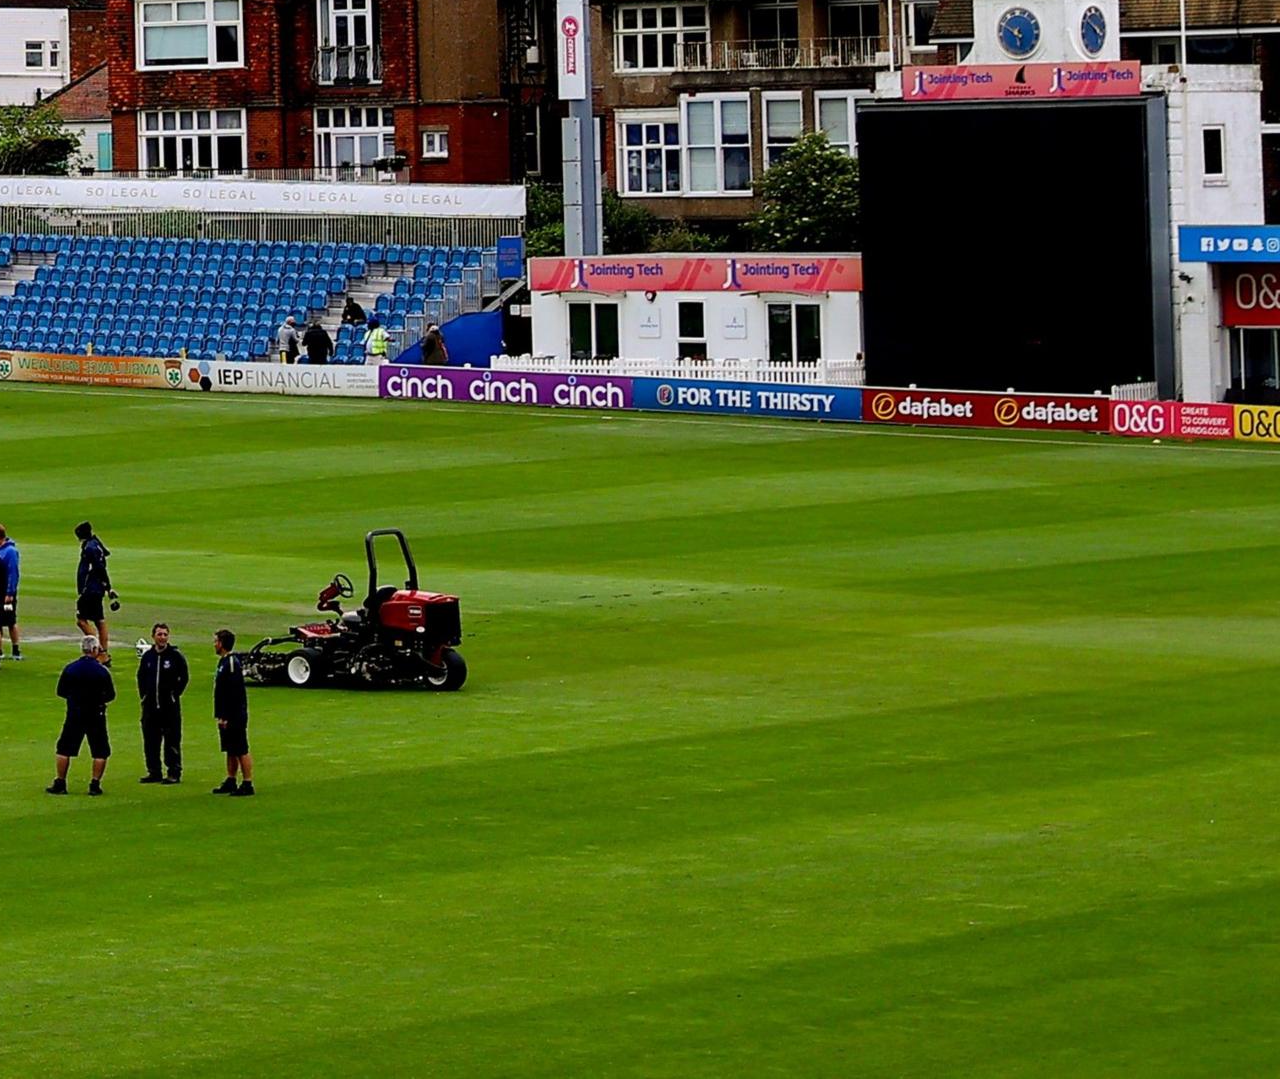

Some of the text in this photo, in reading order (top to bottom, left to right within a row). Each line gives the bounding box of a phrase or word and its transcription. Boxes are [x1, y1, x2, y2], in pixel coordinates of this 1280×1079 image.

[928, 74, 968, 86] Jointing
[970, 72, 992, 83] Tech
[1067, 70, 1108, 82] Jointing
[1111, 69, 1133, 80] Tech
[16, 187, 61, 196] LEGAL
[86, 187, 158, 197] SO LEGAL
[183, 189, 256, 200] SO LEGAL
[283, 191, 357, 202] SO LEGAL
[384, 193, 462, 205] SO LEGAL
[589, 263, 634, 279] Jointing
[637, 262, 663, 276] Tech
[743, 263, 788, 279] Jointing
[792, 262, 820, 276] Tech
[218, 369, 243, 385] IEP
[246, 370, 340, 389] FINANCIAL
[387, 368, 453, 399] cinch
[469, 372, 537, 403] cinch
[554, 376, 624, 407] cinch
[678, 387, 712, 406] FOR
[716, 388, 751, 408] THE
[757, 391, 835, 412] THIRSTY
[898, 396, 973, 418] dafabet
[1022, 401, 1098, 424] dafabet
[1181, 407, 1209, 416] CREATE
[1114, 404, 1164, 433] O&G
[1181, 416, 1227, 426] TO CONVERT
[1239, 409, 1280, 438] O&
